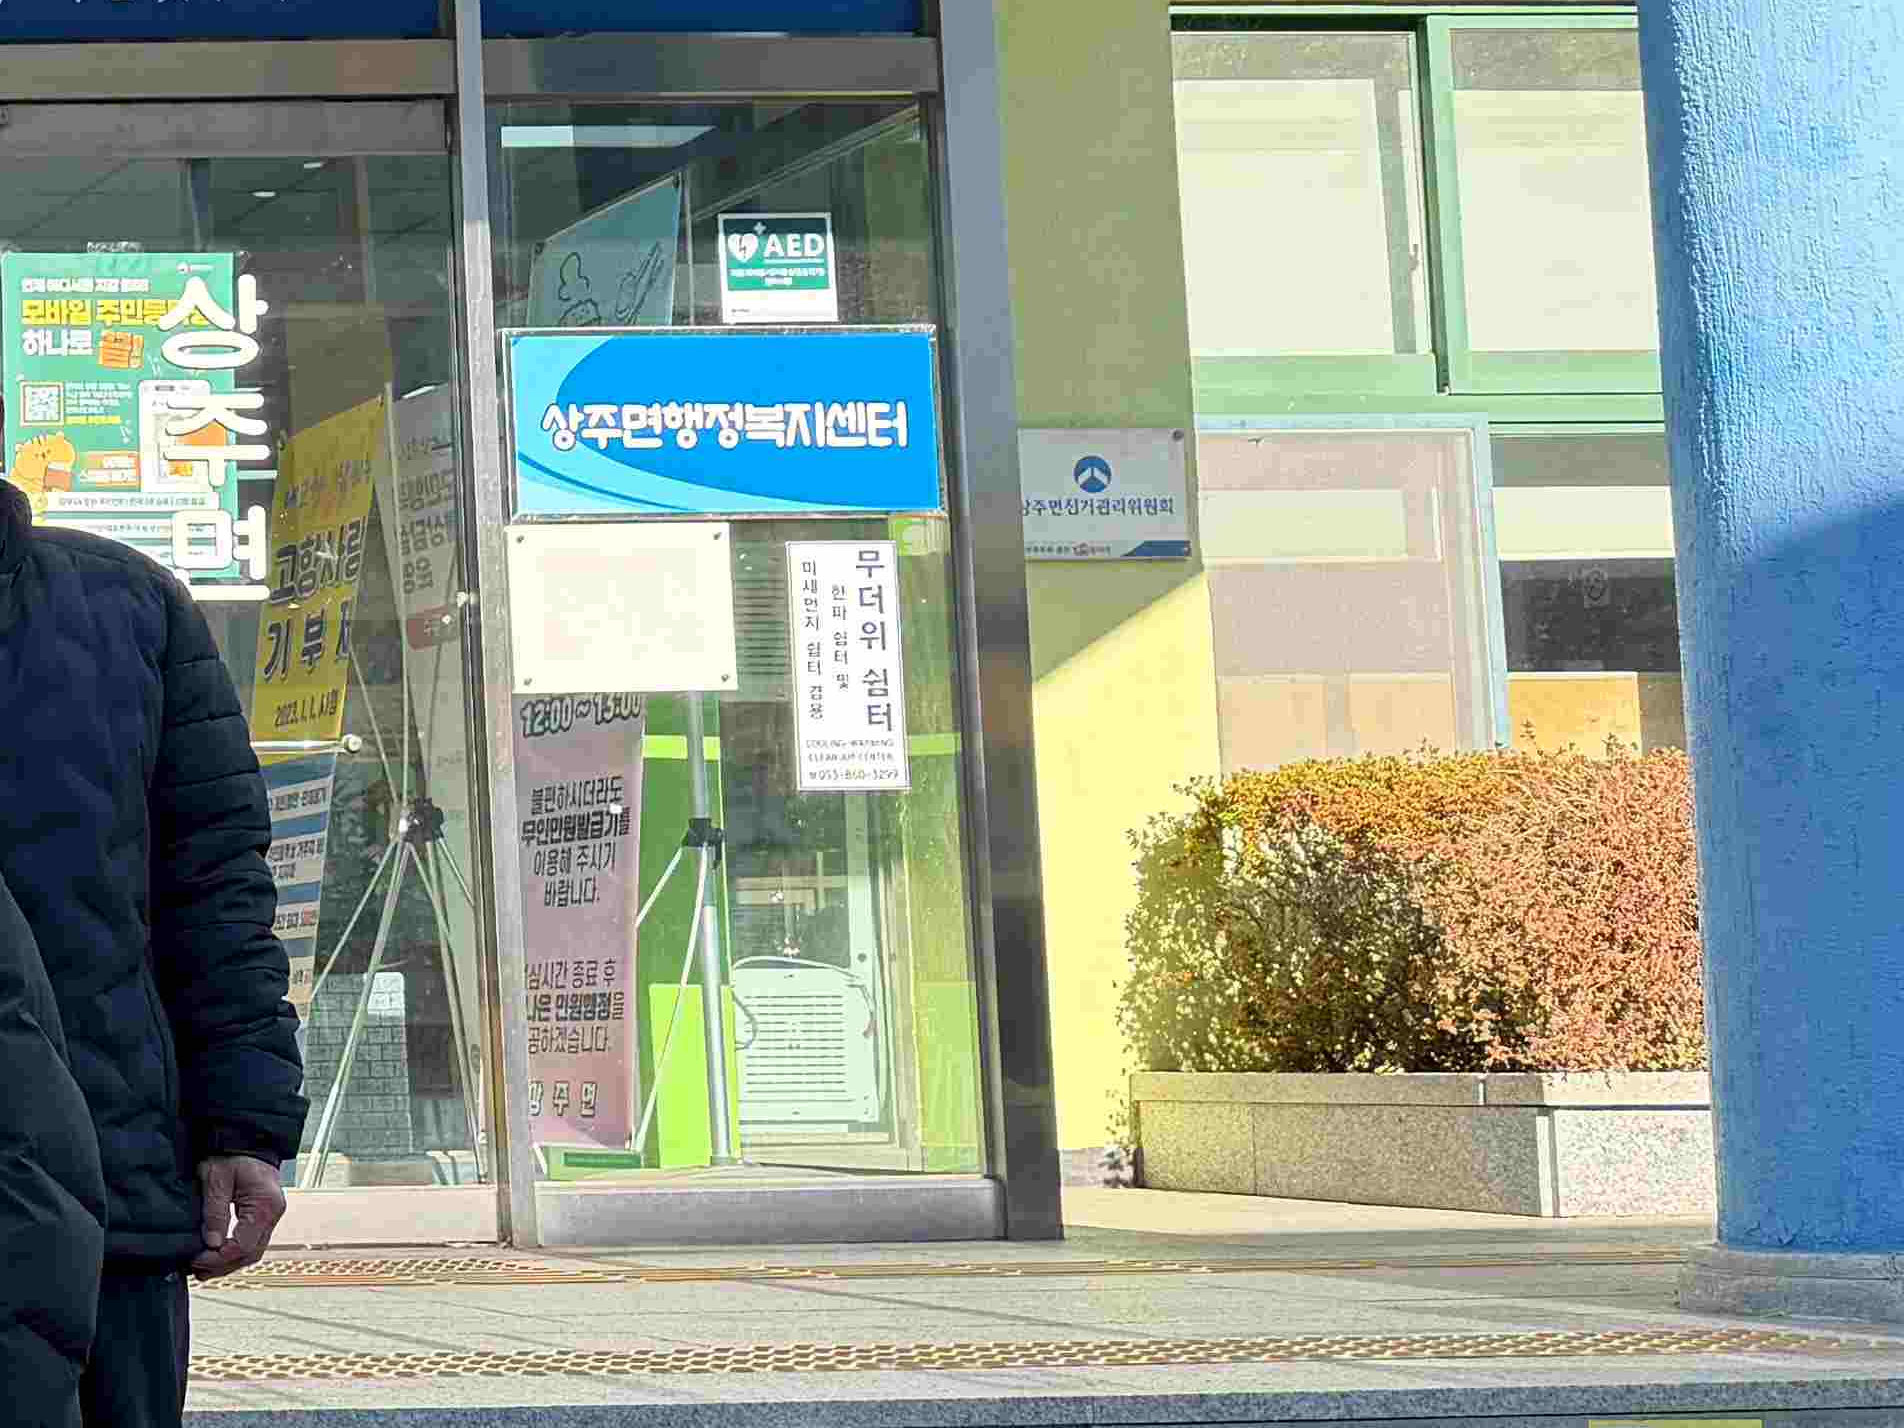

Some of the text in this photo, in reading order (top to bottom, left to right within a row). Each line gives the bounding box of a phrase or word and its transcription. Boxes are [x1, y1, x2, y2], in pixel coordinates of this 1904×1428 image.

[763, 234, 824, 257] AED
[22, 300, 91, 326] 모바일
[22, 329, 91, 356] 하나로
[541, 403, 909, 452] 상주면행정복지센터
[802, 560, 819, 631] 미세먼지
[856, 550, 892, 732] 무더위 쉼터
[532, 775, 623, 815] 불편하시더라도
[521, 807, 631, 846] 무인민원발급기를
[534, 842, 616, 876] 이용해 주시기
[544, 876, 600, 907] 바랍니다.
[572, 960, 598, 989] 종료
[604, 958, 616, 987] 후
